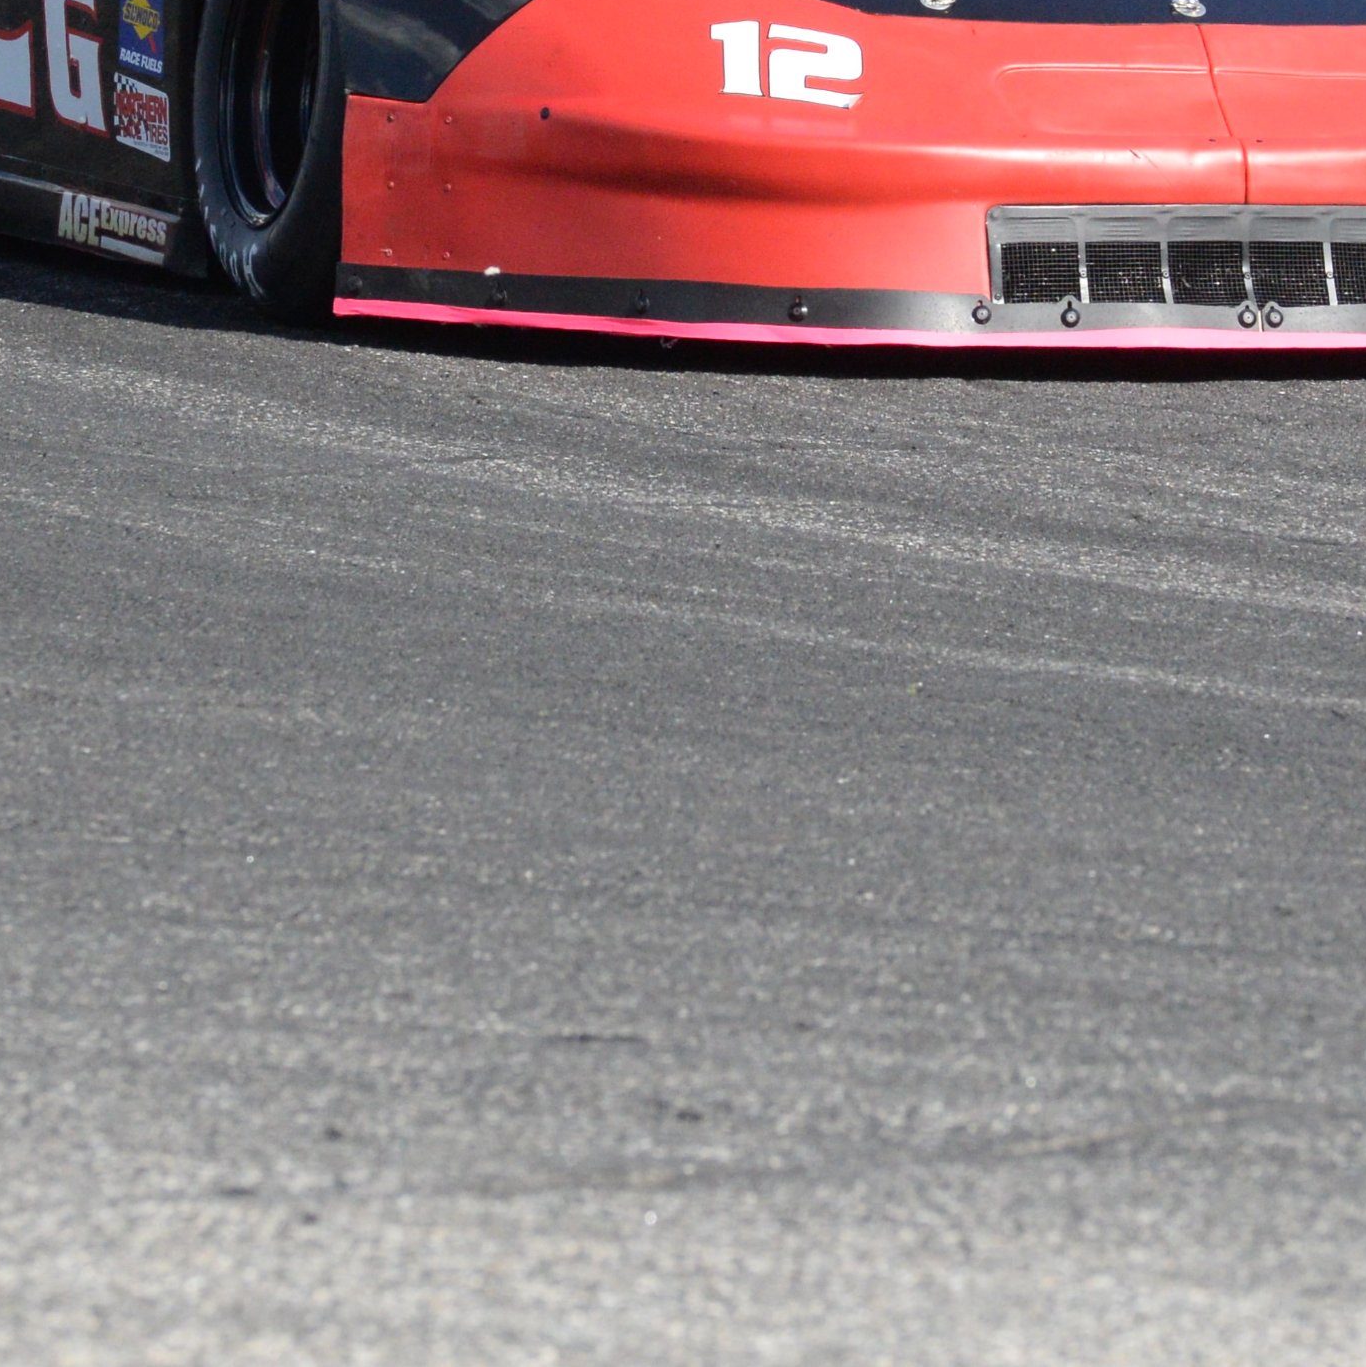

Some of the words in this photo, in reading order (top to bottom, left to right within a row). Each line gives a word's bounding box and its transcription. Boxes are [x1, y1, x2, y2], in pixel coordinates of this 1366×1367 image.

[123, 0, 160, 31] SUNOCO
[119, 47, 141, 67] RACE
[141, 56, 164, 74] FUELS
[709, 19, 864, 109] 12
[115, 90, 168, 125] NORTHERN
[58, 191, 101, 247] ACE
[100, 201, 168, 246] Express
